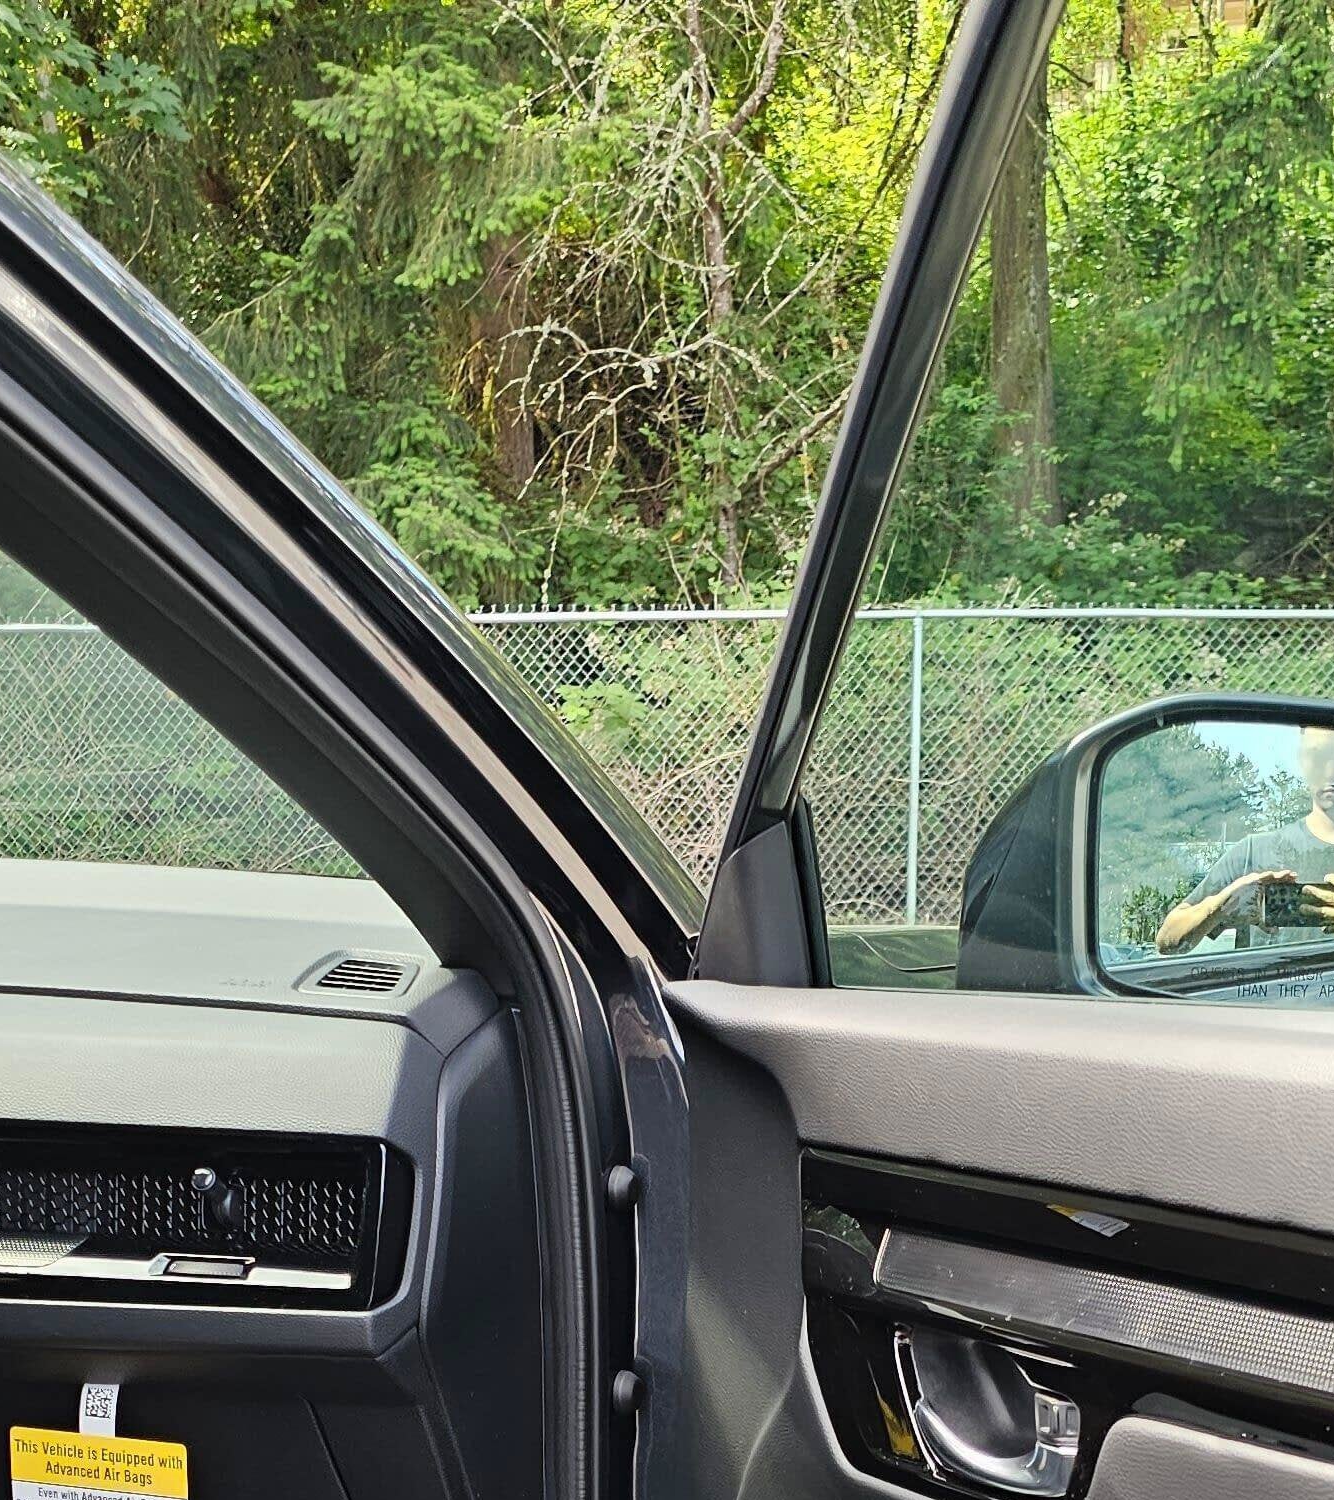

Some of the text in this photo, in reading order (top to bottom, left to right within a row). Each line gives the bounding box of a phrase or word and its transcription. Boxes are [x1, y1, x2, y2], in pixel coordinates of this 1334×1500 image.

[1254, 968, 1268, 980] IN
[1237, 985, 1267, 998] THAN
[1278, 985, 1308, 998] THEY
[15, 1439, 182, 1469] This Vehicle is Equipped with
[46, 1461, 152, 1486] Advanced Air Bags
[38, 1488, 58, 1498] Even
